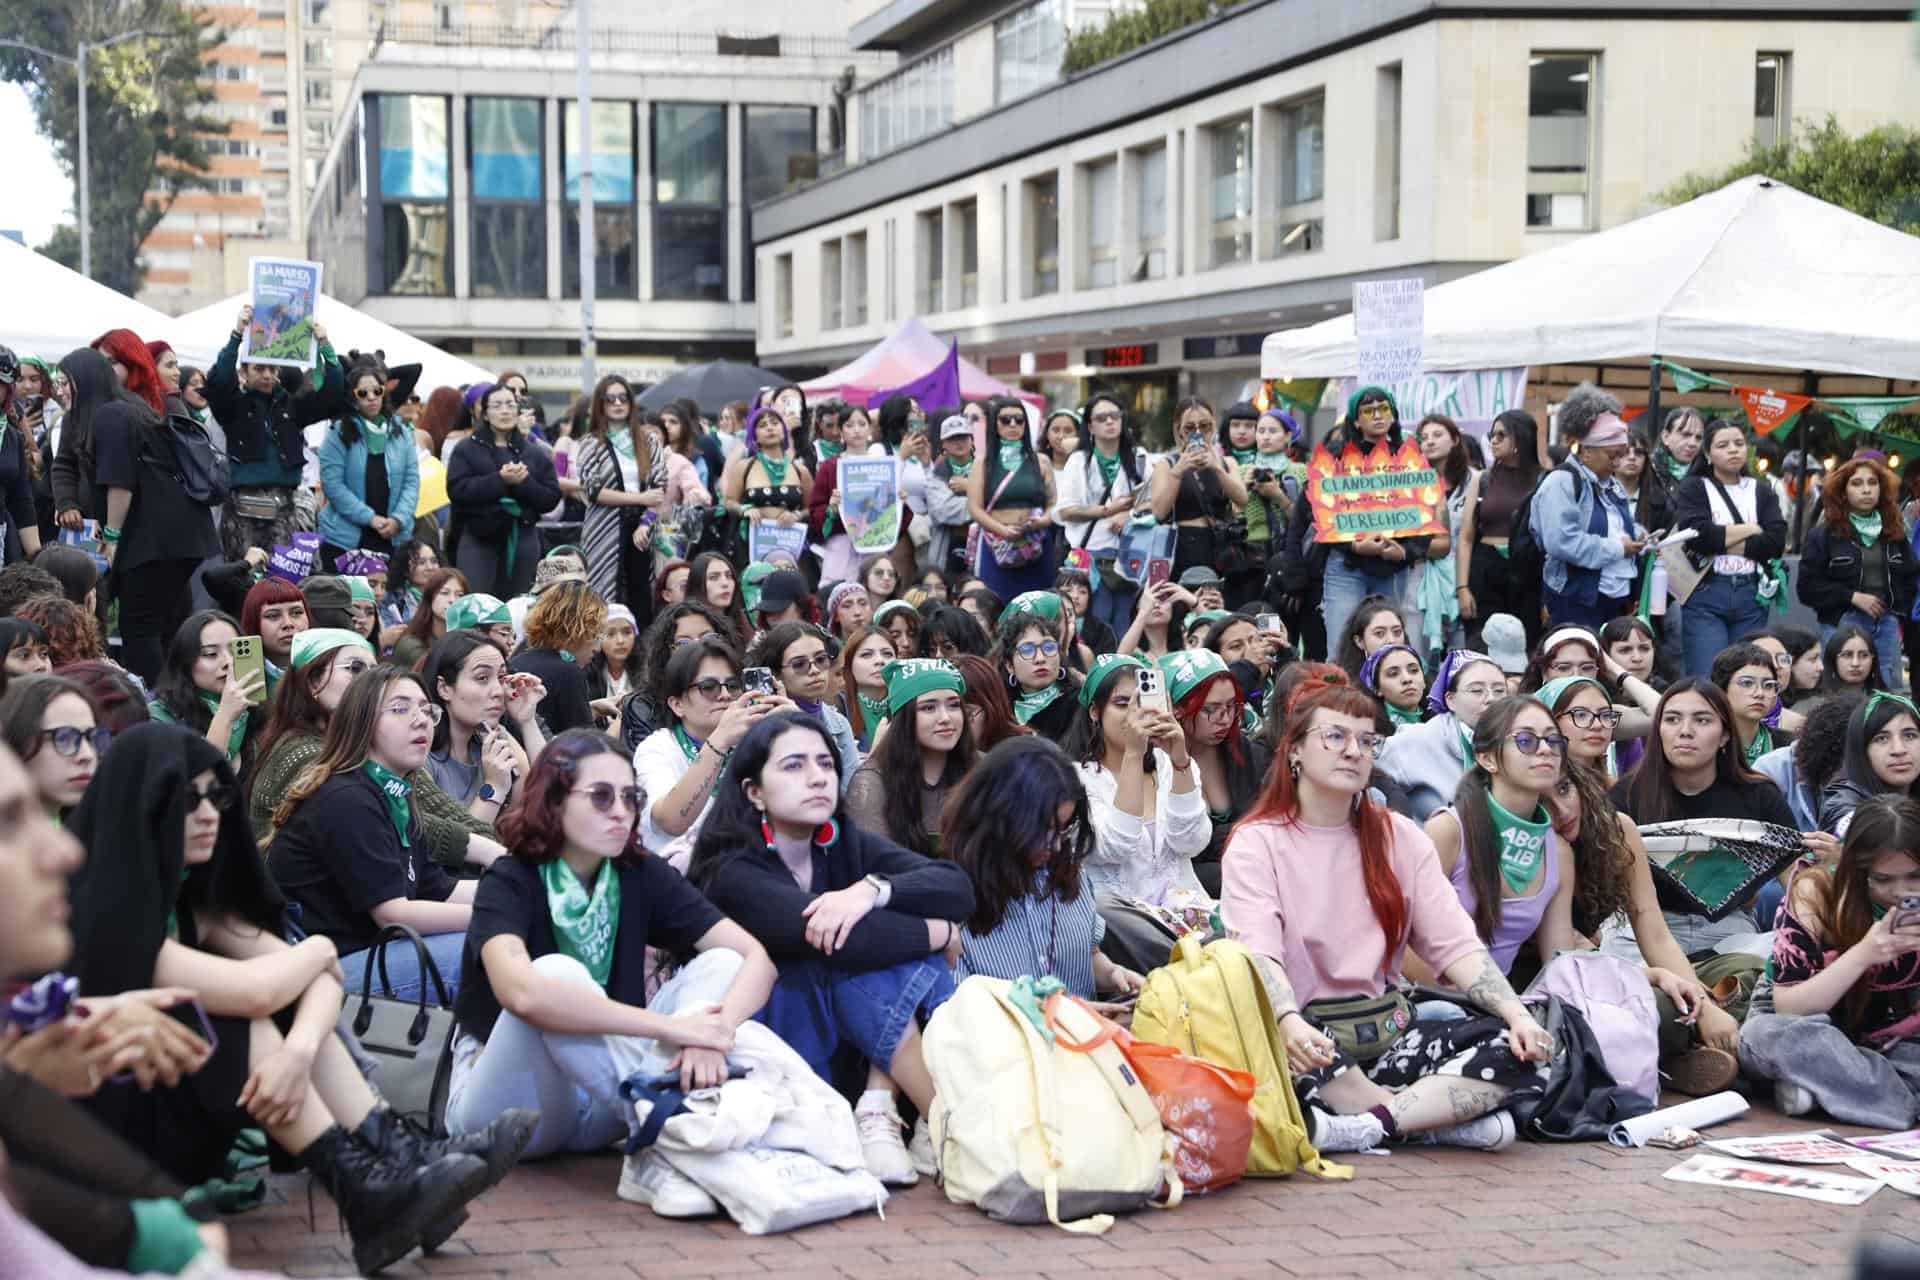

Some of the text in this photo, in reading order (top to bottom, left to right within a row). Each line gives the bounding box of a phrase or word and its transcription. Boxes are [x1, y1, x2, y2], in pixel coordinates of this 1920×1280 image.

[1321, 471, 1435, 493] CLANDESTINIDAD
[1335, 511, 1418, 530] DERECHOS
[1502, 845, 1536, 866] LIB
